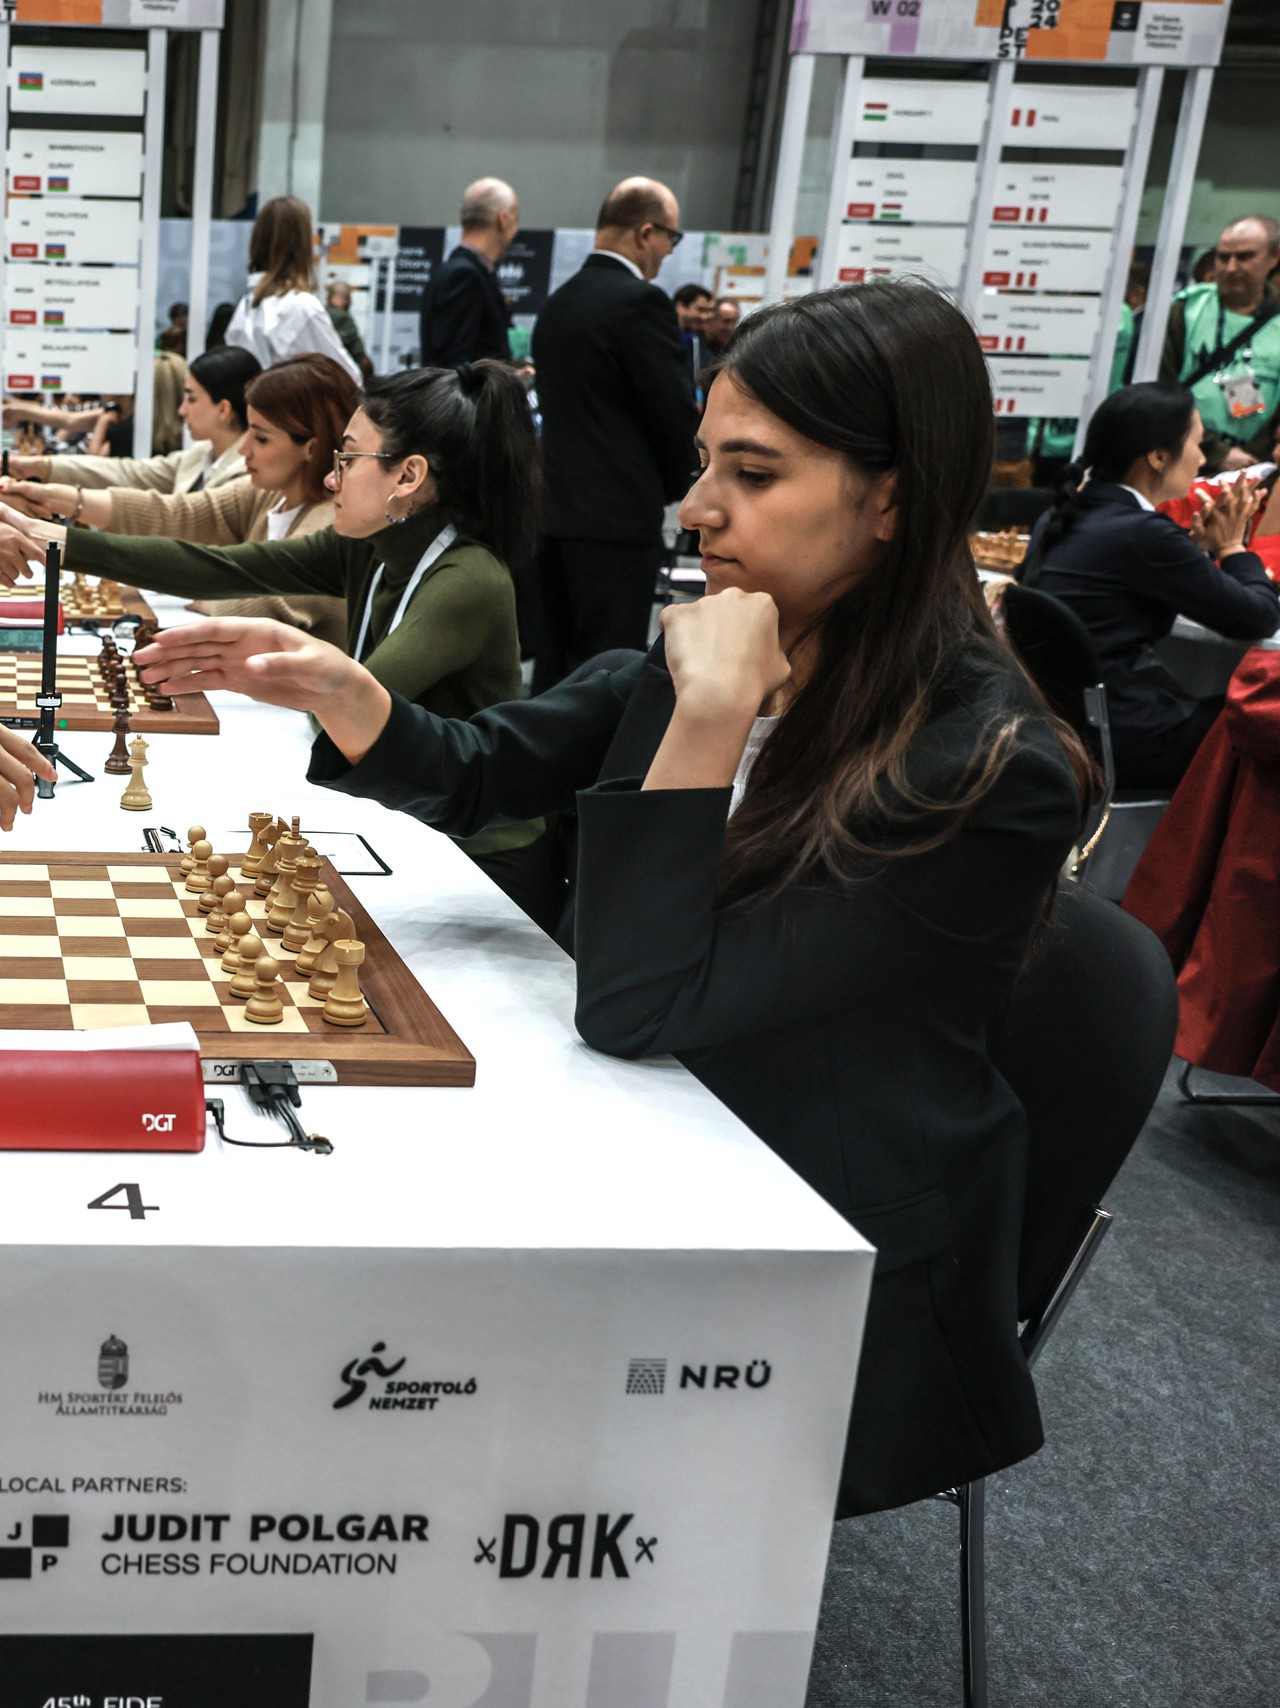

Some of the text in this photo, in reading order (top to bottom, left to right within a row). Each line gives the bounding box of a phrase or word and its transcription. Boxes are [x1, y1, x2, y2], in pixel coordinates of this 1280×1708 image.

[872, 0, 919, 16] W 02
[1031, 0, 1060, 13] 20
[1029, 15, 1057, 28] 24
[214, 1065, 237, 1077] DGT
[142, 1114, 176, 1131] DGT
[87, 1183, 160, 1220] 4
[680, 1360, 771, 1389] NRÜ
[385, 1379, 478, 1395] SPORTOLÓ
[38, 1392, 63, 1403] HM
[369, 1397, 439, 1410] NEMZET
[72, 1477, 186, 1493] PARTNERS:
[7, 1522, 22, 1540] J
[102, 1514, 428, 1542] JUDIT POLGAR
[42, 1554, 58, 1572] P
[101, 1553, 396, 1575] CHESS FOUNDATION
